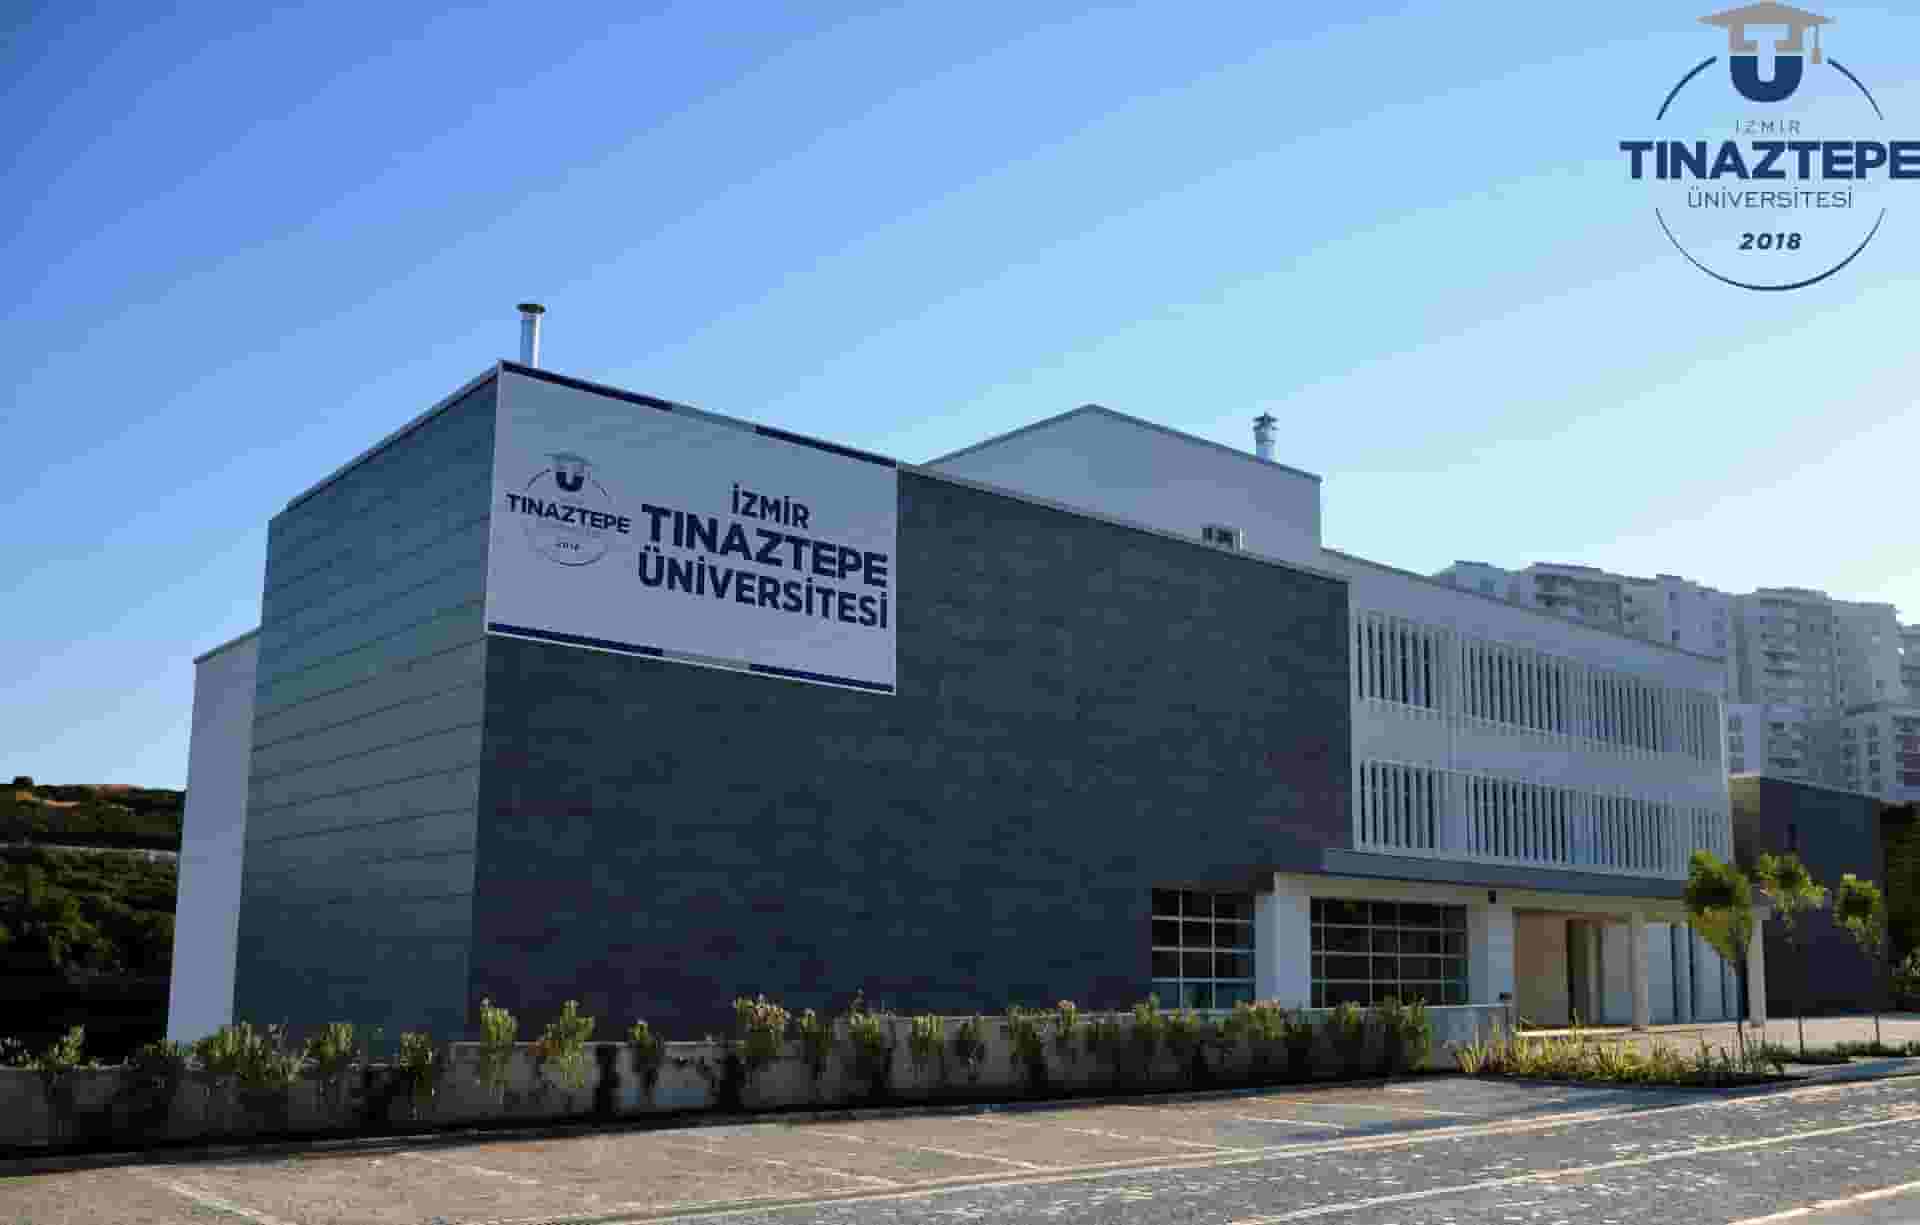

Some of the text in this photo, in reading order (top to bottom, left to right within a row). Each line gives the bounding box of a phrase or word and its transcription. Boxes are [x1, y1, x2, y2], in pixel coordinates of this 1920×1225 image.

[505, 493, 632, 534] TINAZTEPE
[731, 483, 810, 529] İZMİR
[641, 503, 888, 588] TINAZTEPE
[638, 544, 888, 629] ÜNİVERSİTESİ
